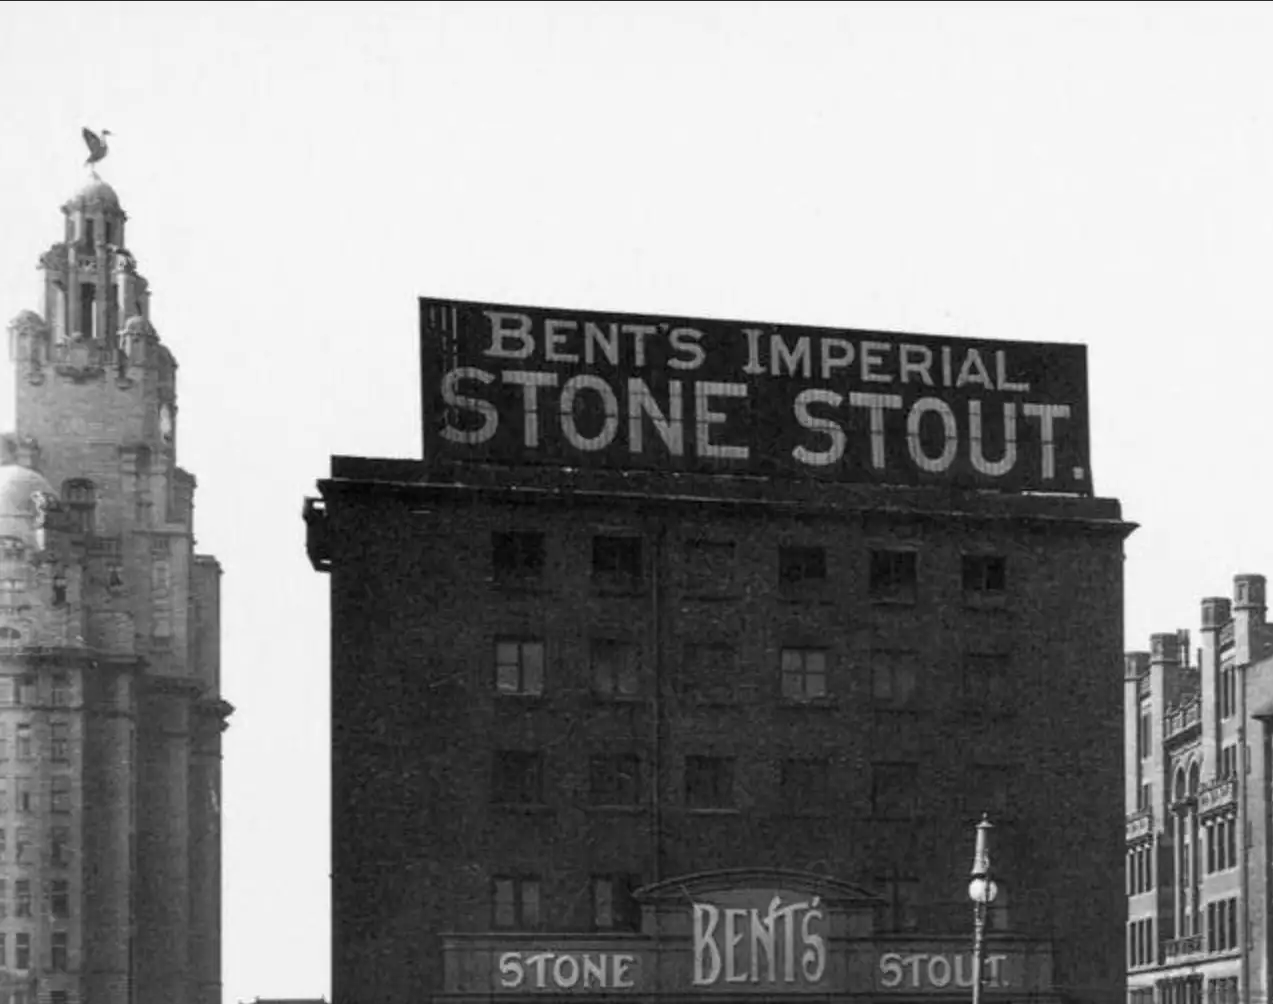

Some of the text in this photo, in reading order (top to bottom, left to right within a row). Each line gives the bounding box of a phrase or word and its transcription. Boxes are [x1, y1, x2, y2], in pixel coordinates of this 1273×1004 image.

[481, 309, 1031, 392] BENT'S IMPERIAL
[439, 365, 1085, 480] STONE STOUT.
[499, 952, 636, 988] STONE
